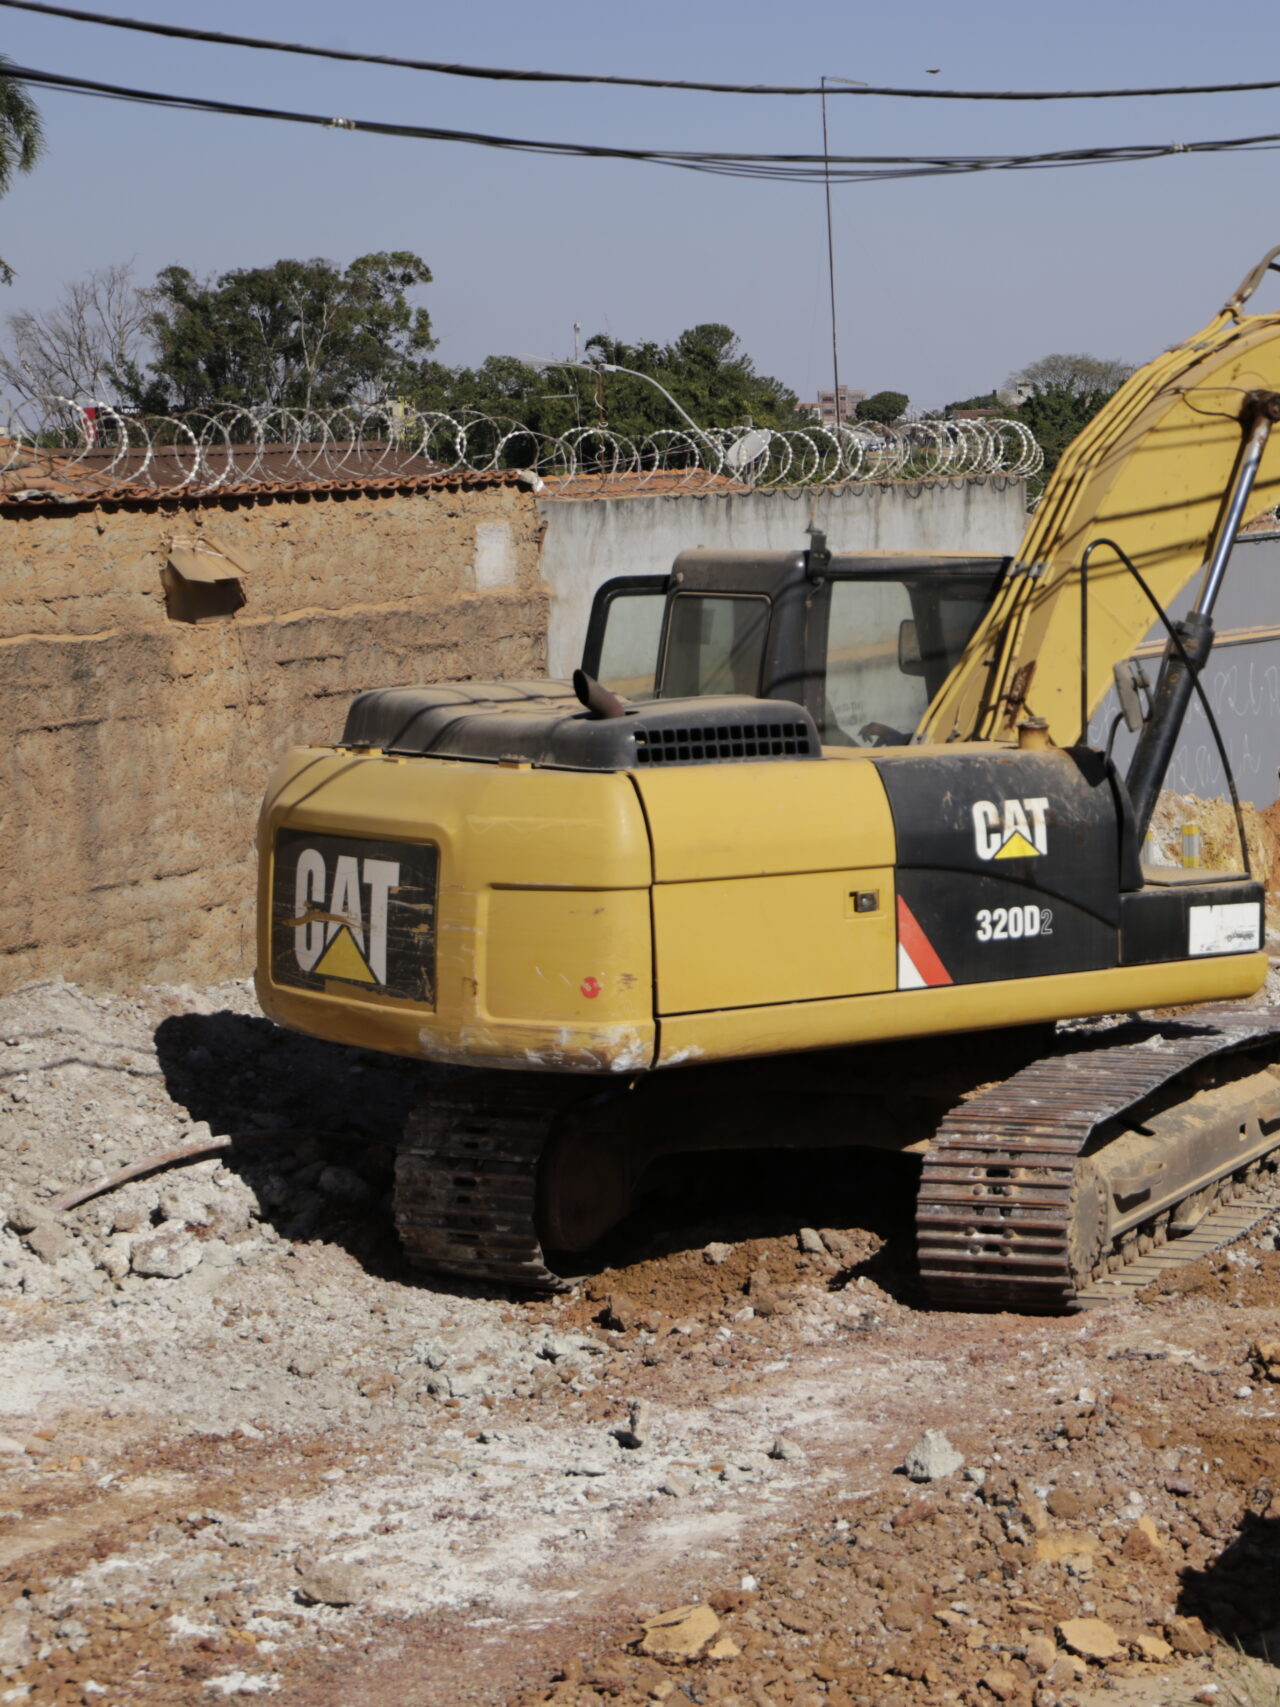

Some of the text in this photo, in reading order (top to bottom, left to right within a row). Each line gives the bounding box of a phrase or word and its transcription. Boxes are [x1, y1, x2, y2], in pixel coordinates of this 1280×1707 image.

[972, 797, 1050, 861] CAT
[294, 848, 400, 985] CAT
[976, 904, 1053, 942] 320D2
